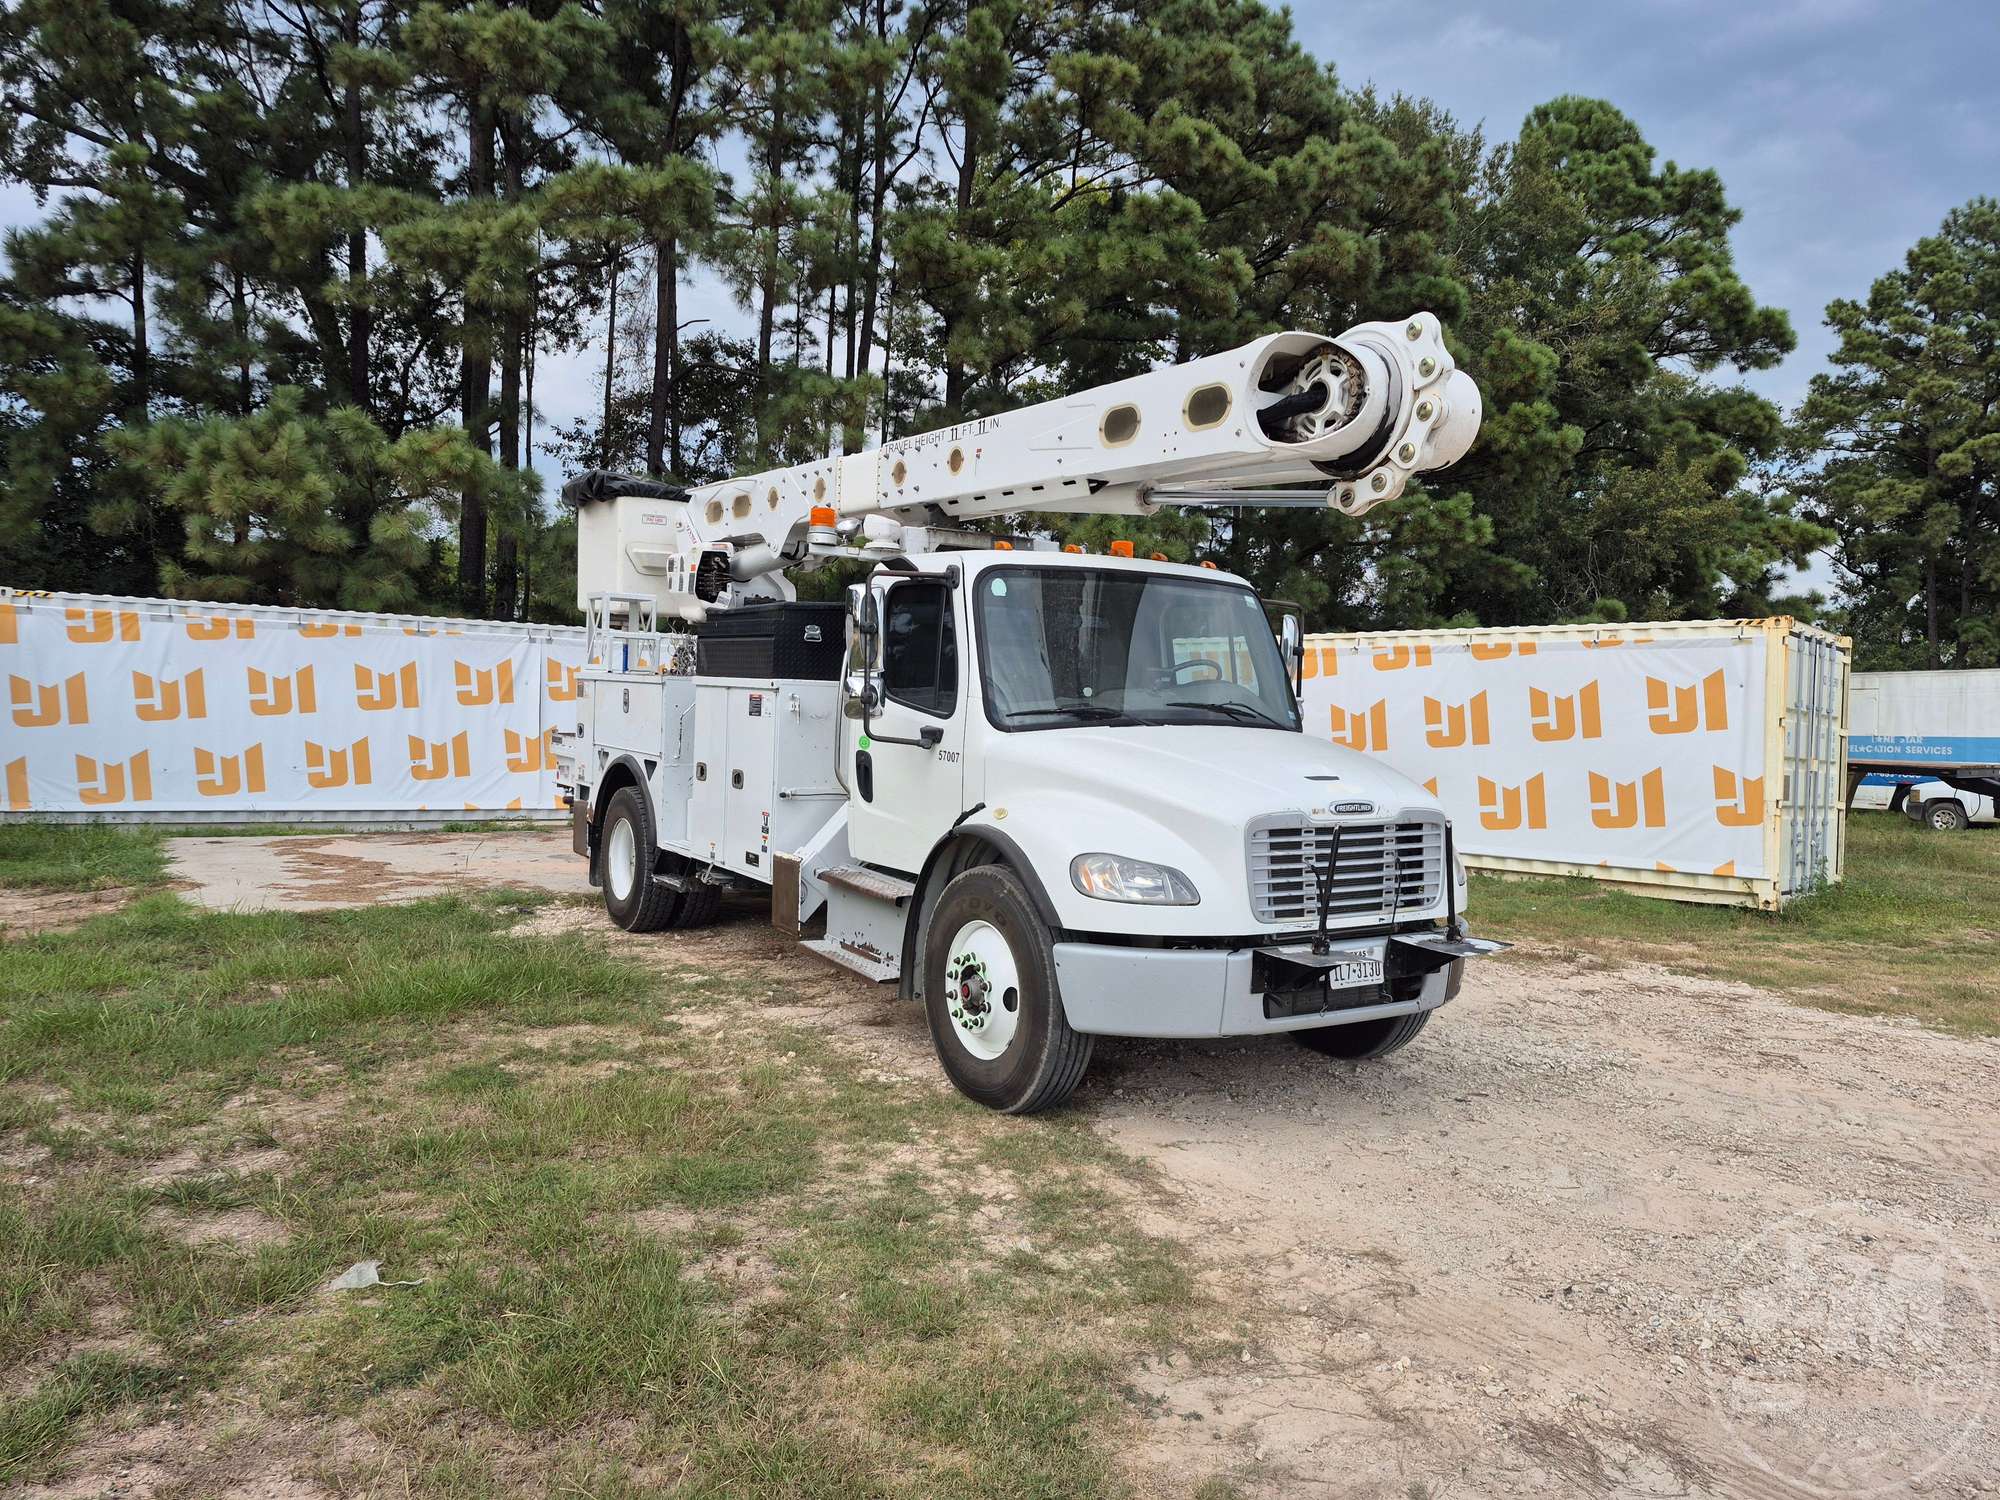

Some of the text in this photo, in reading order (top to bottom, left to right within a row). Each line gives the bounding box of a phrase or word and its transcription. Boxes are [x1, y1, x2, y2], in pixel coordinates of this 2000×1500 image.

[884, 440, 913, 455] TRAVEL
[914, 430, 946, 448] HEIGHT
[949, 427, 959, 441] 11
[977, 419, 987, 435] 11
[938, 750, 960, 763] 57007
[1905, 745, 1953, 756] SERVICES
[1336, 803, 1372, 813] FREIGHTLINER
